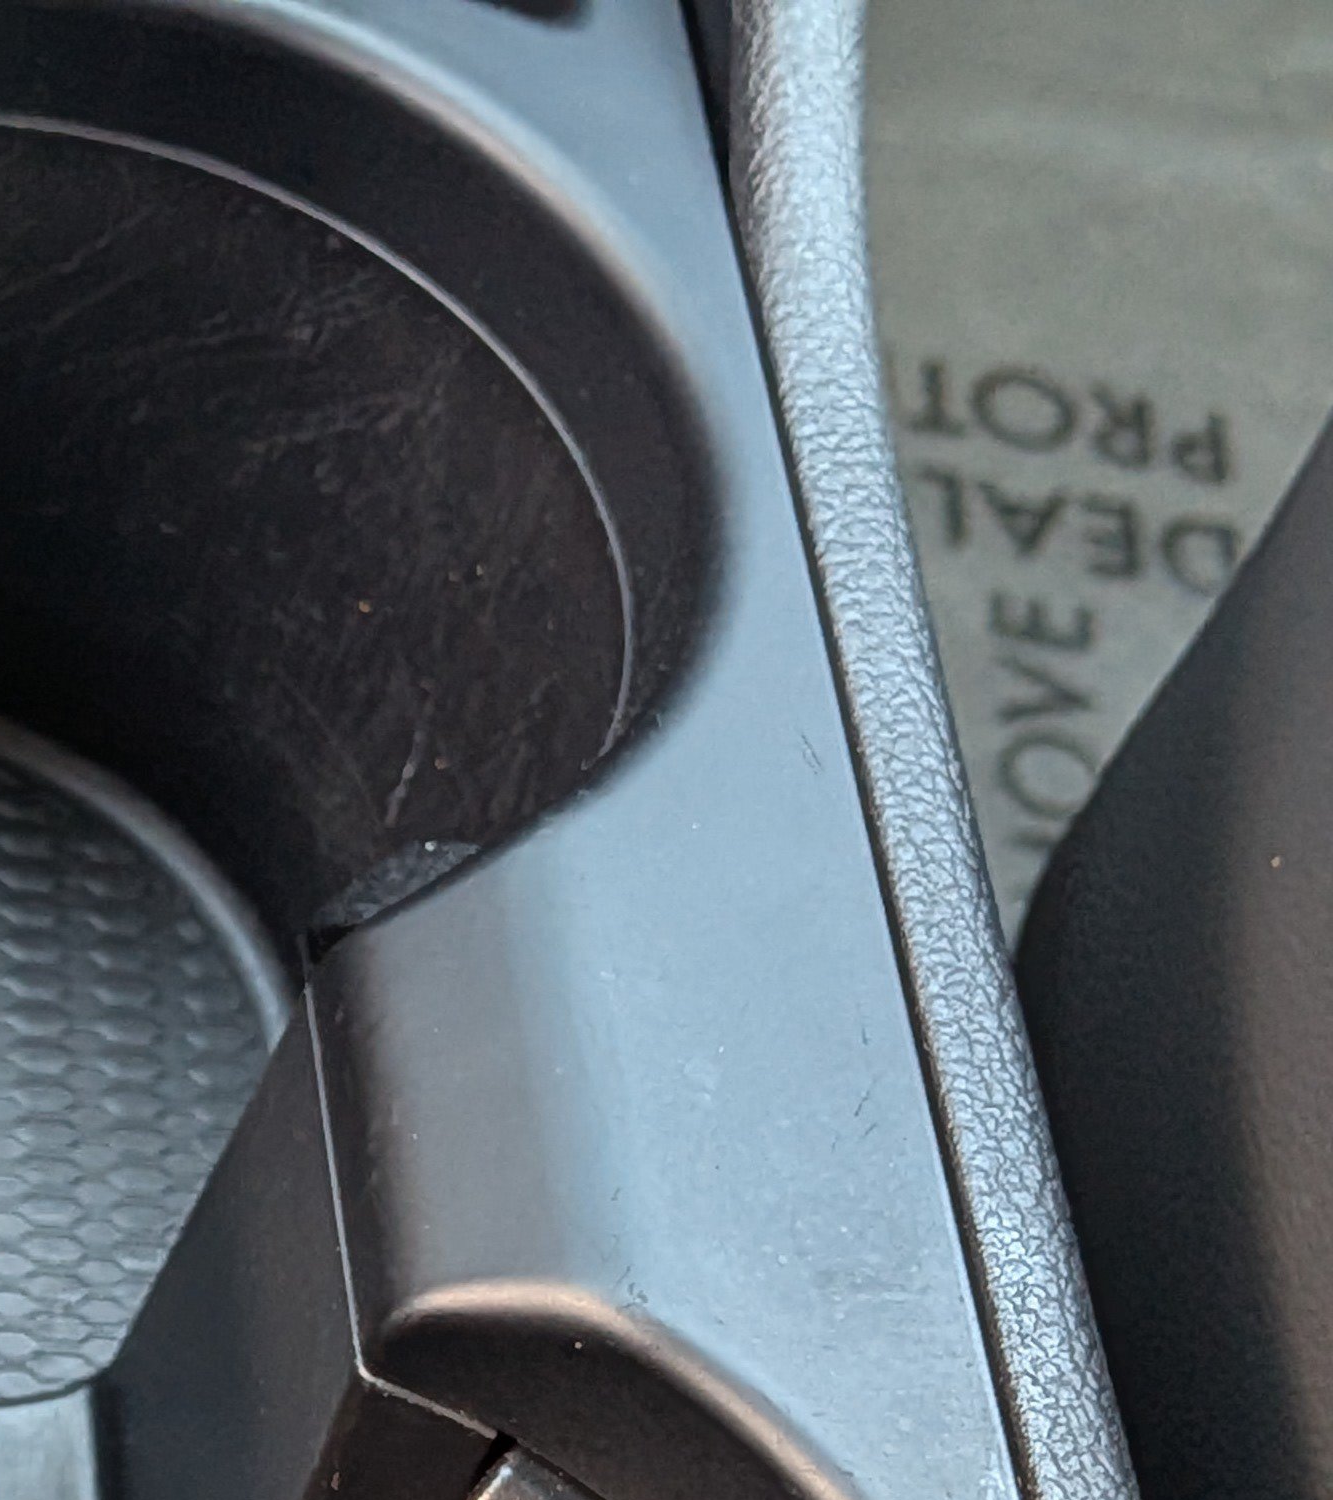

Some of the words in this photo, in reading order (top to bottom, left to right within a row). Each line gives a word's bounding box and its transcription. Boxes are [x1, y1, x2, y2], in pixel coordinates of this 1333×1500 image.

[890, 357, 1233, 488] PROT
[917, 463, 1242, 599] DEAL
[988, 588, 1099, 846] OVE
